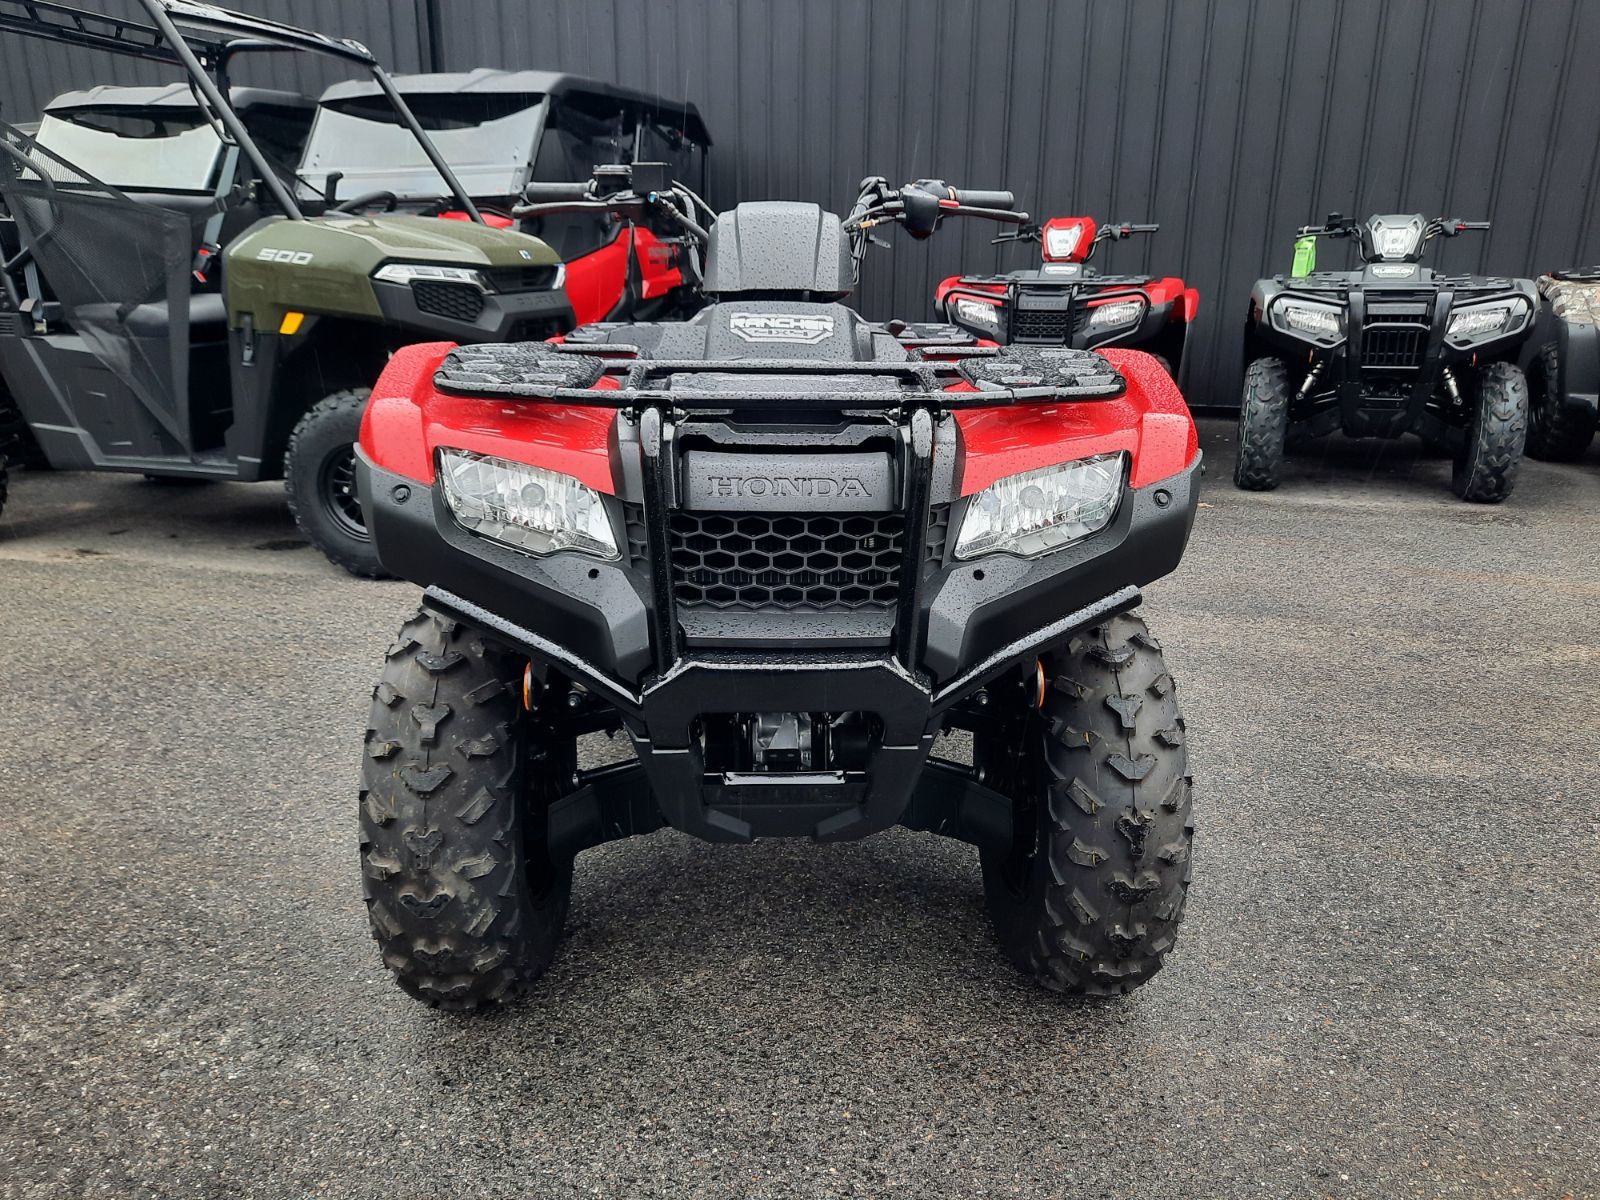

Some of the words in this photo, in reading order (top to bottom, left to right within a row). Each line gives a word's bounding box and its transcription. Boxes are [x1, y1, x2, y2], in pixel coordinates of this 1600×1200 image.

[256, 247, 313, 265] 500
[730, 315, 833, 332] RANCHER
[707, 476, 873, 498] HONDA
